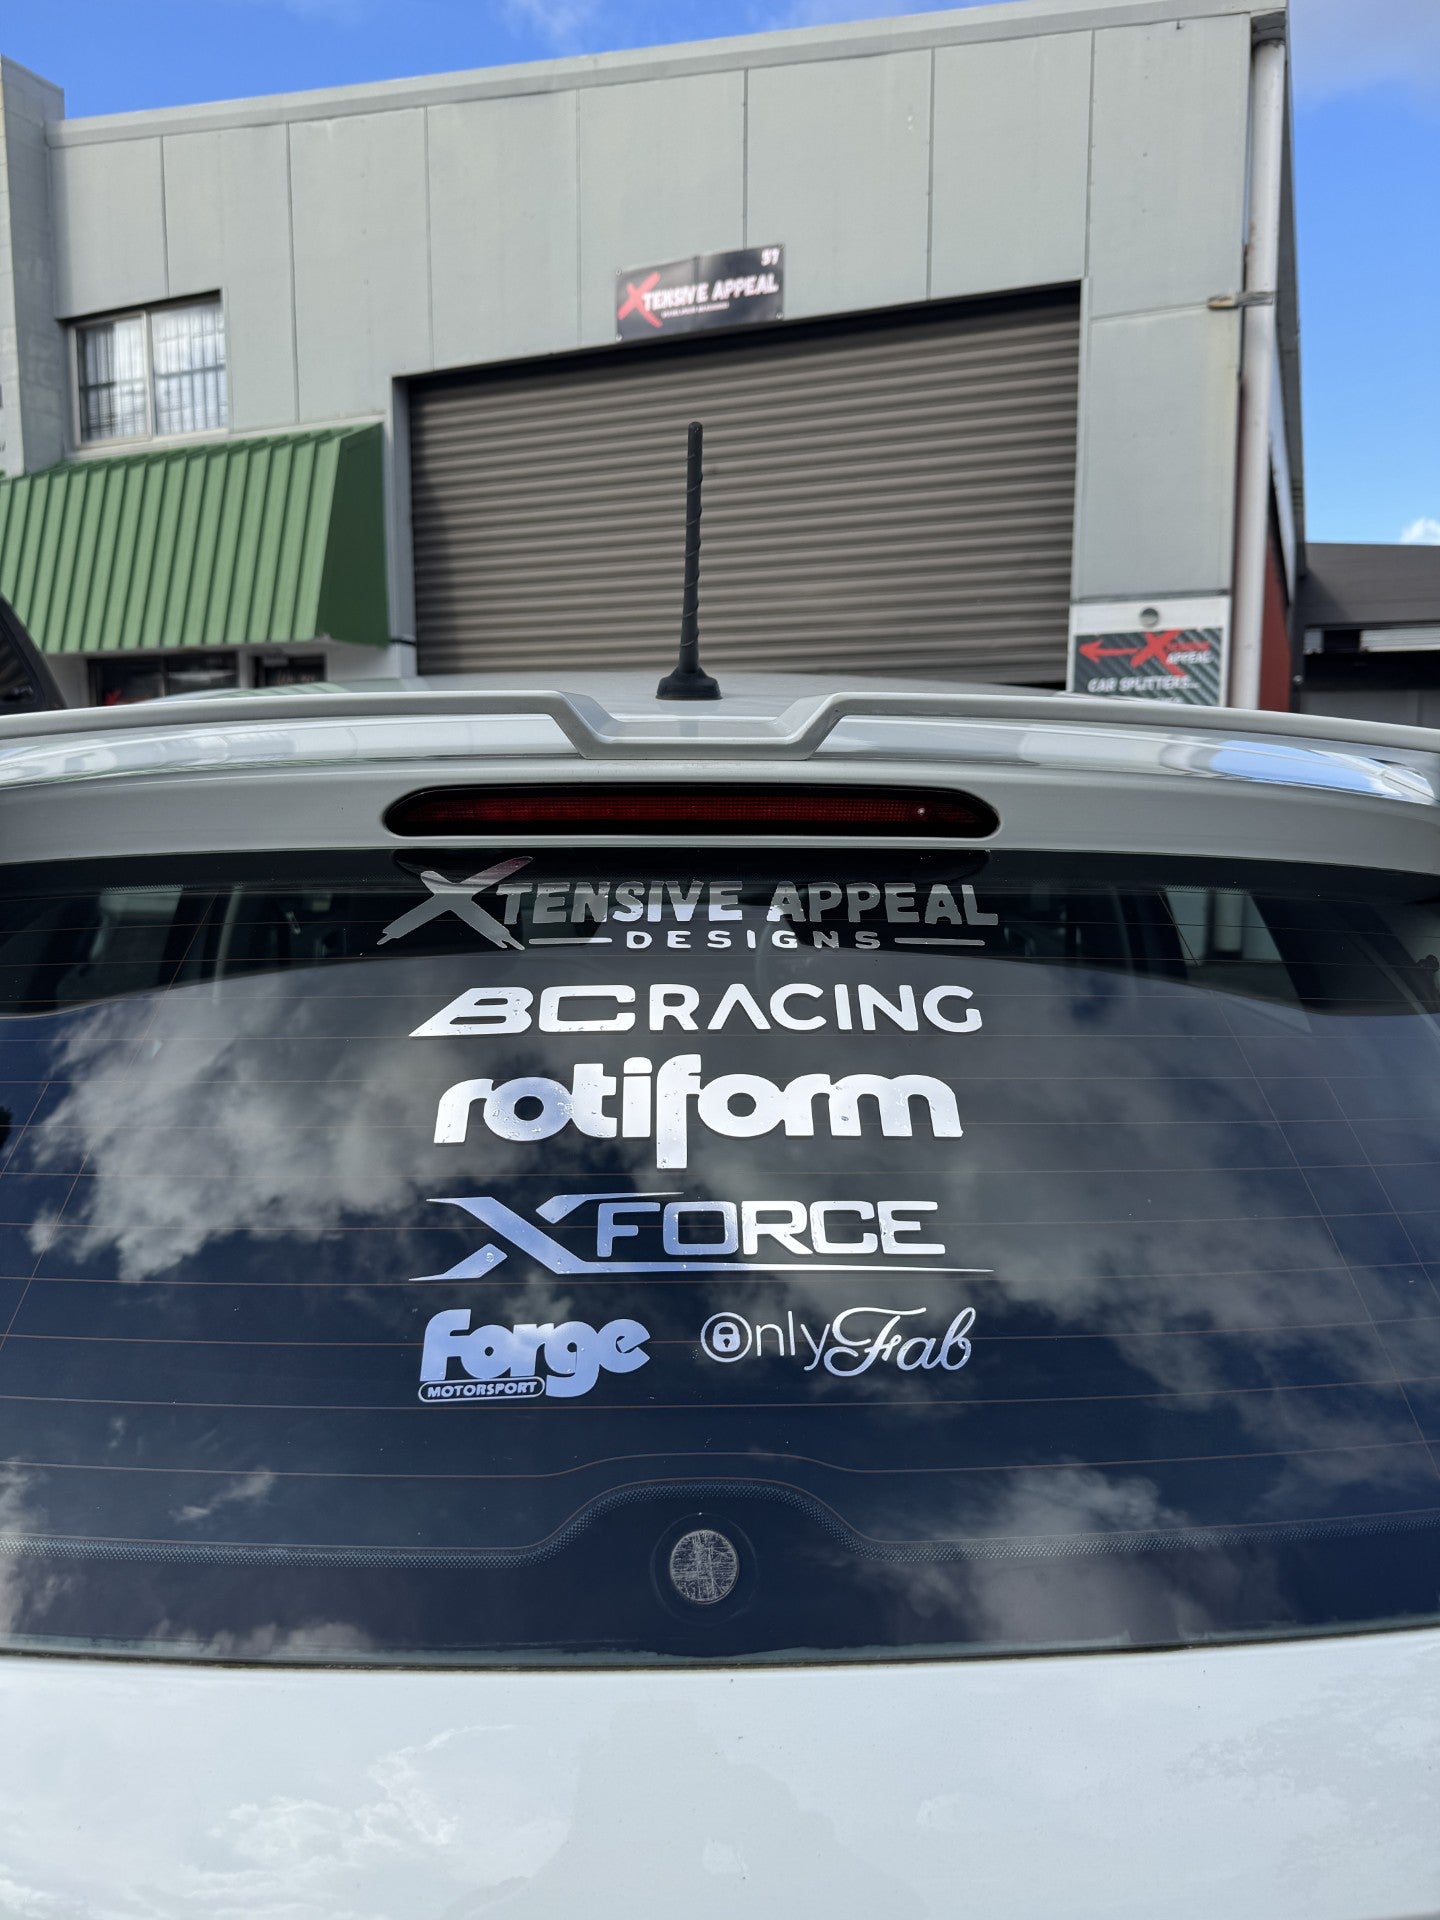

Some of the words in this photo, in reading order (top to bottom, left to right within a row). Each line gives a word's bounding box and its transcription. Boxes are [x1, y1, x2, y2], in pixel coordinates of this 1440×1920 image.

[711, 273, 779, 301] APPEAL
[1087, 677, 1117, 693] CAR
[376, 856, 743, 951] XTENSIVE
[766, 881, 999, 926] APPEAL
[626, 931, 881, 950] DESIGNS
[433, 1054, 963, 1169] rotiform
[408, 1191, 994, 1281] XFORCE
[426, 1381, 539, 1399] MOTORSPORT
